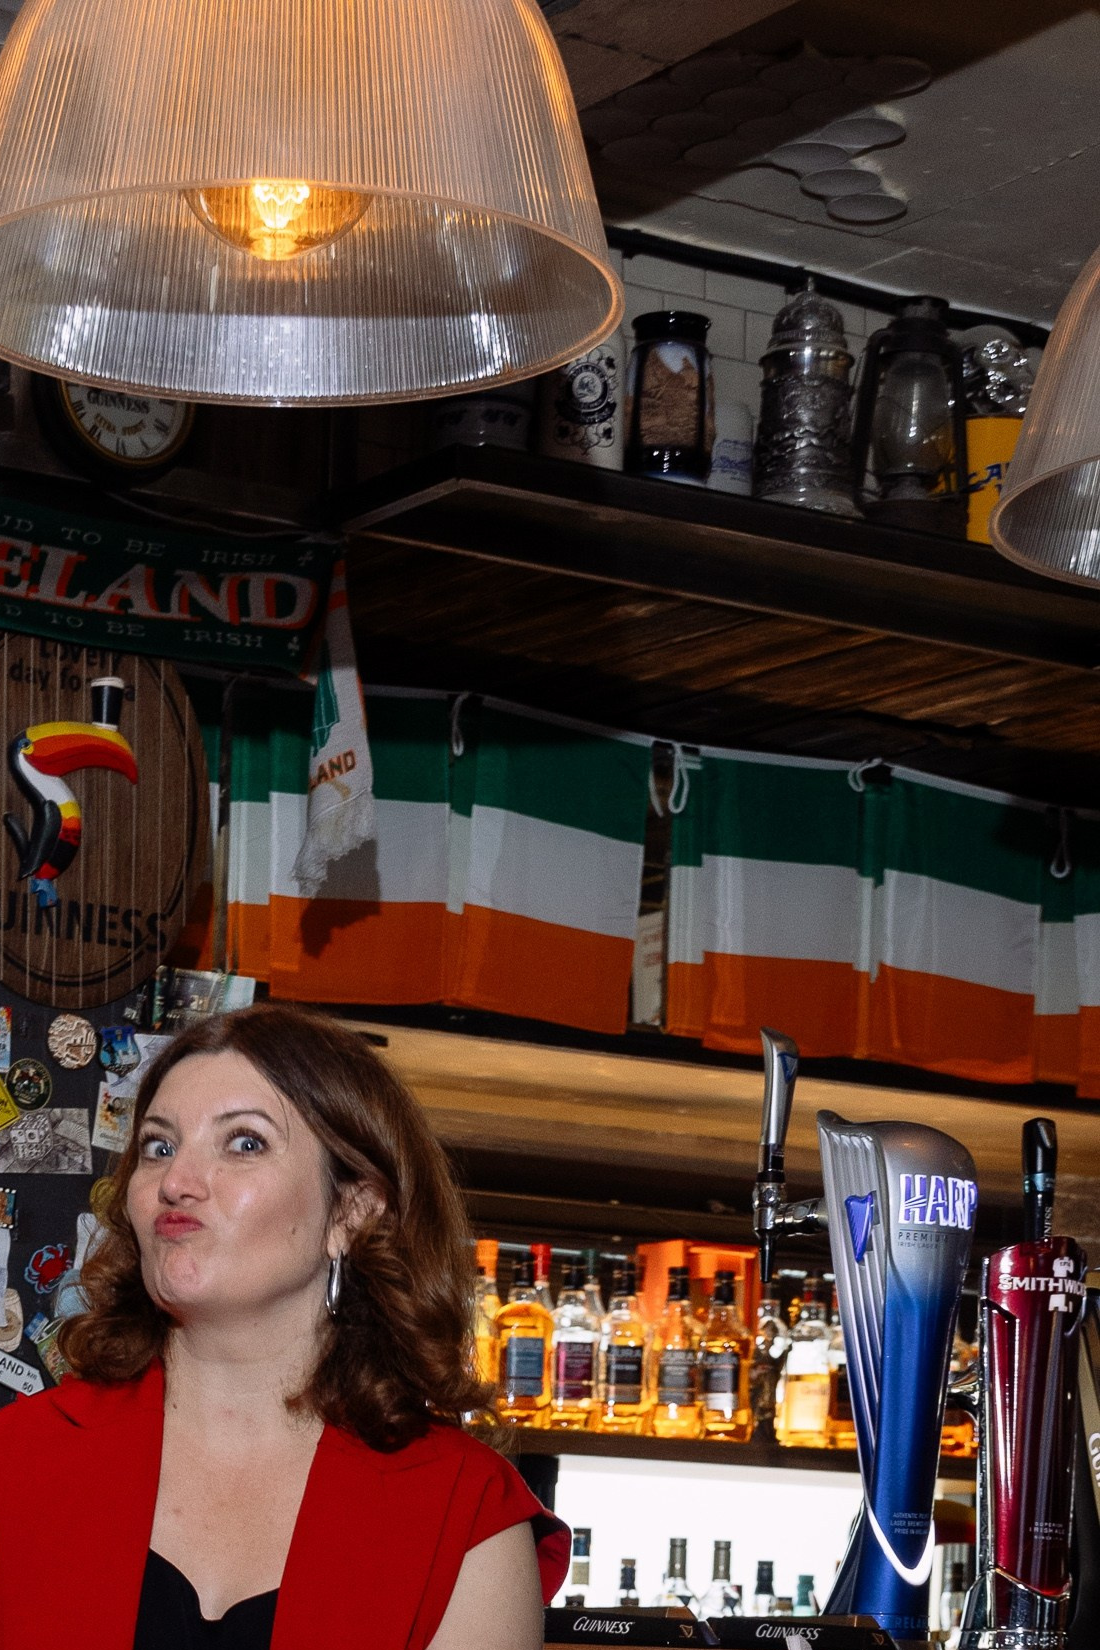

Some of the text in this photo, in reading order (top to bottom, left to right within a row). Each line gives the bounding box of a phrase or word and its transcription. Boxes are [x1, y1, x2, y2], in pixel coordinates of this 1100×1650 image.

[87, 389, 150, 414] GUINNESS
[60, 525, 101, 545] TO
[124, 537, 168, 558] BE
[200, 548, 277, 567] IRISH
[47, 609, 85, 627] TO
[105, 619, 147, 639] BE
[183, 628, 264, 649] IRISH
[9, 657, 51, 692] day
[898, 1173, 979, 1231] HARP
[898, 1231, 949, 1243] PREMIUM
[573, 1616, 635, 1635] GUINNESS
[755, 1623, 822, 1641] GUINNESS
